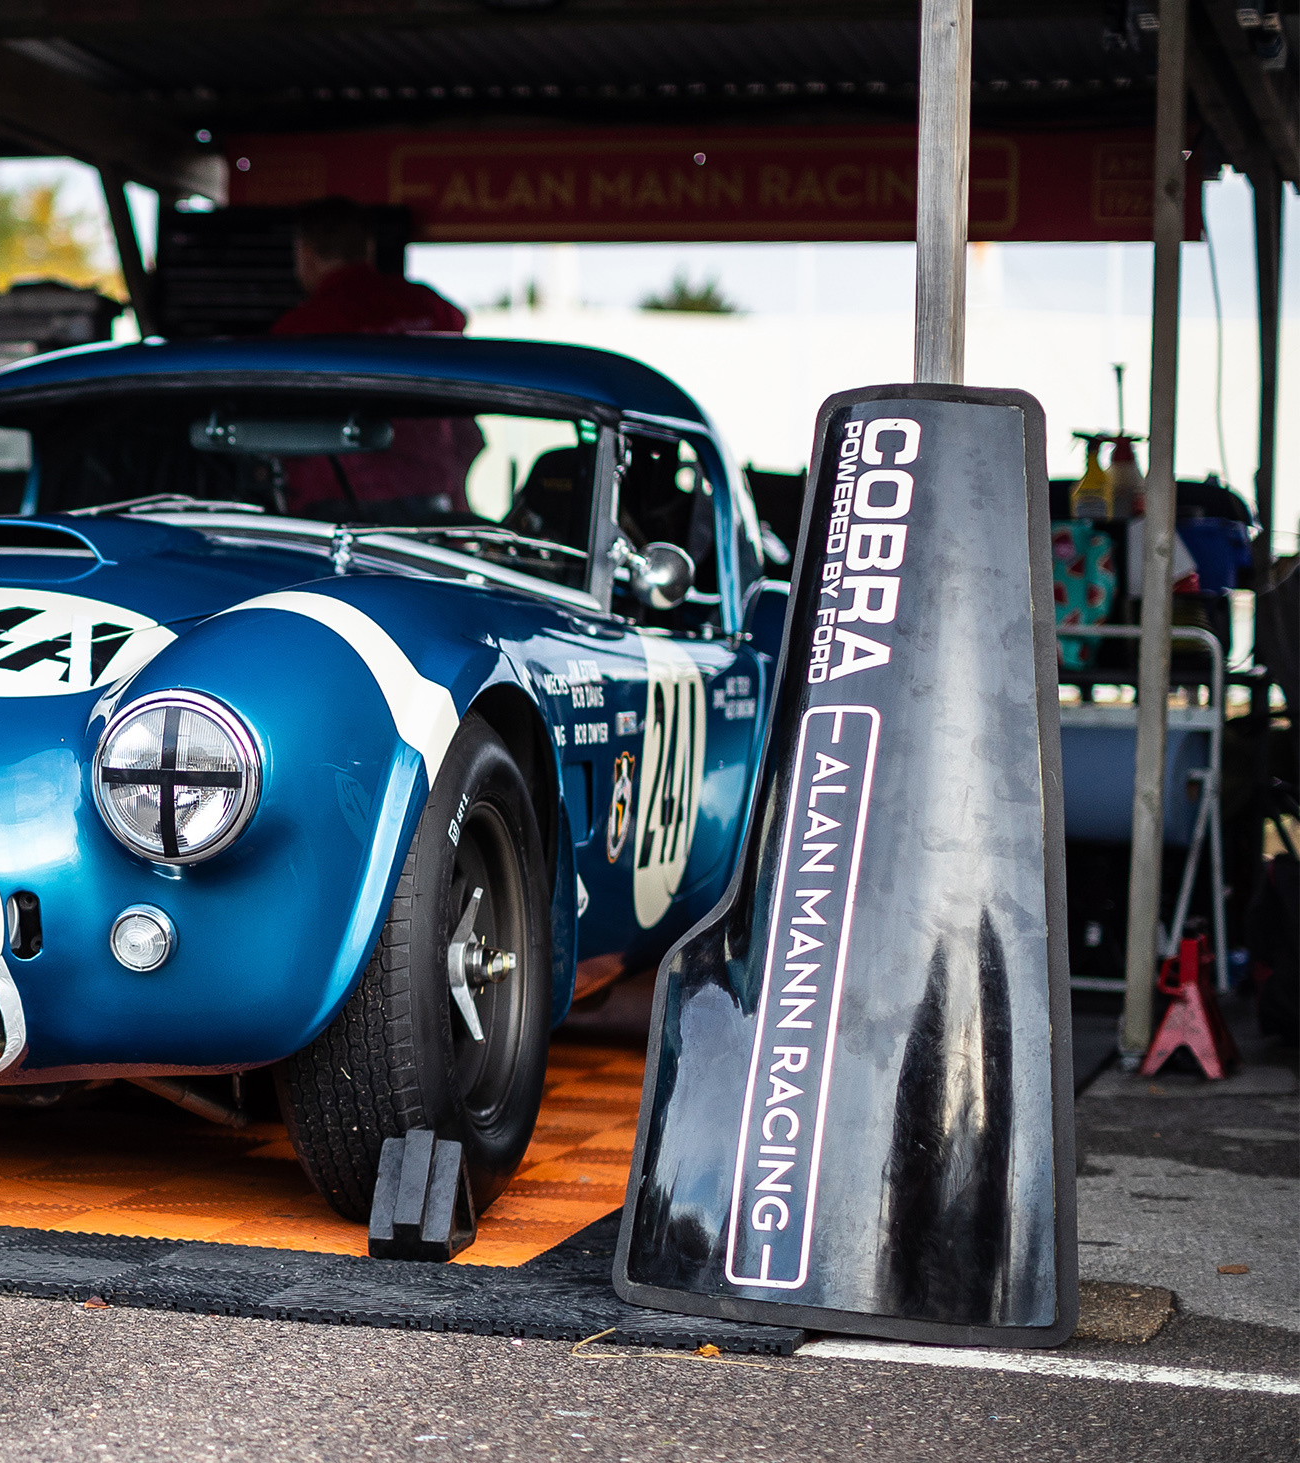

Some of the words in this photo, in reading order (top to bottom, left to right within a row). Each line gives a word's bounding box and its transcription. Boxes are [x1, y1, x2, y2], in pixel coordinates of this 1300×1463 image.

[441, 168, 576, 213] ALAN
[588, 165, 744, 212] MANN
[756, 162, 917, 212] RACIN
[826, 420, 864, 555] POWERED
[829, 417, 922, 681] COBRA
[820, 560, 844, 599] BY
[807, 607, 837, 684] FORD
[801, 751, 850, 873] ALAN
[776, 887, 833, 1030] MANN
[750, 1045, 810, 1232] RACING
